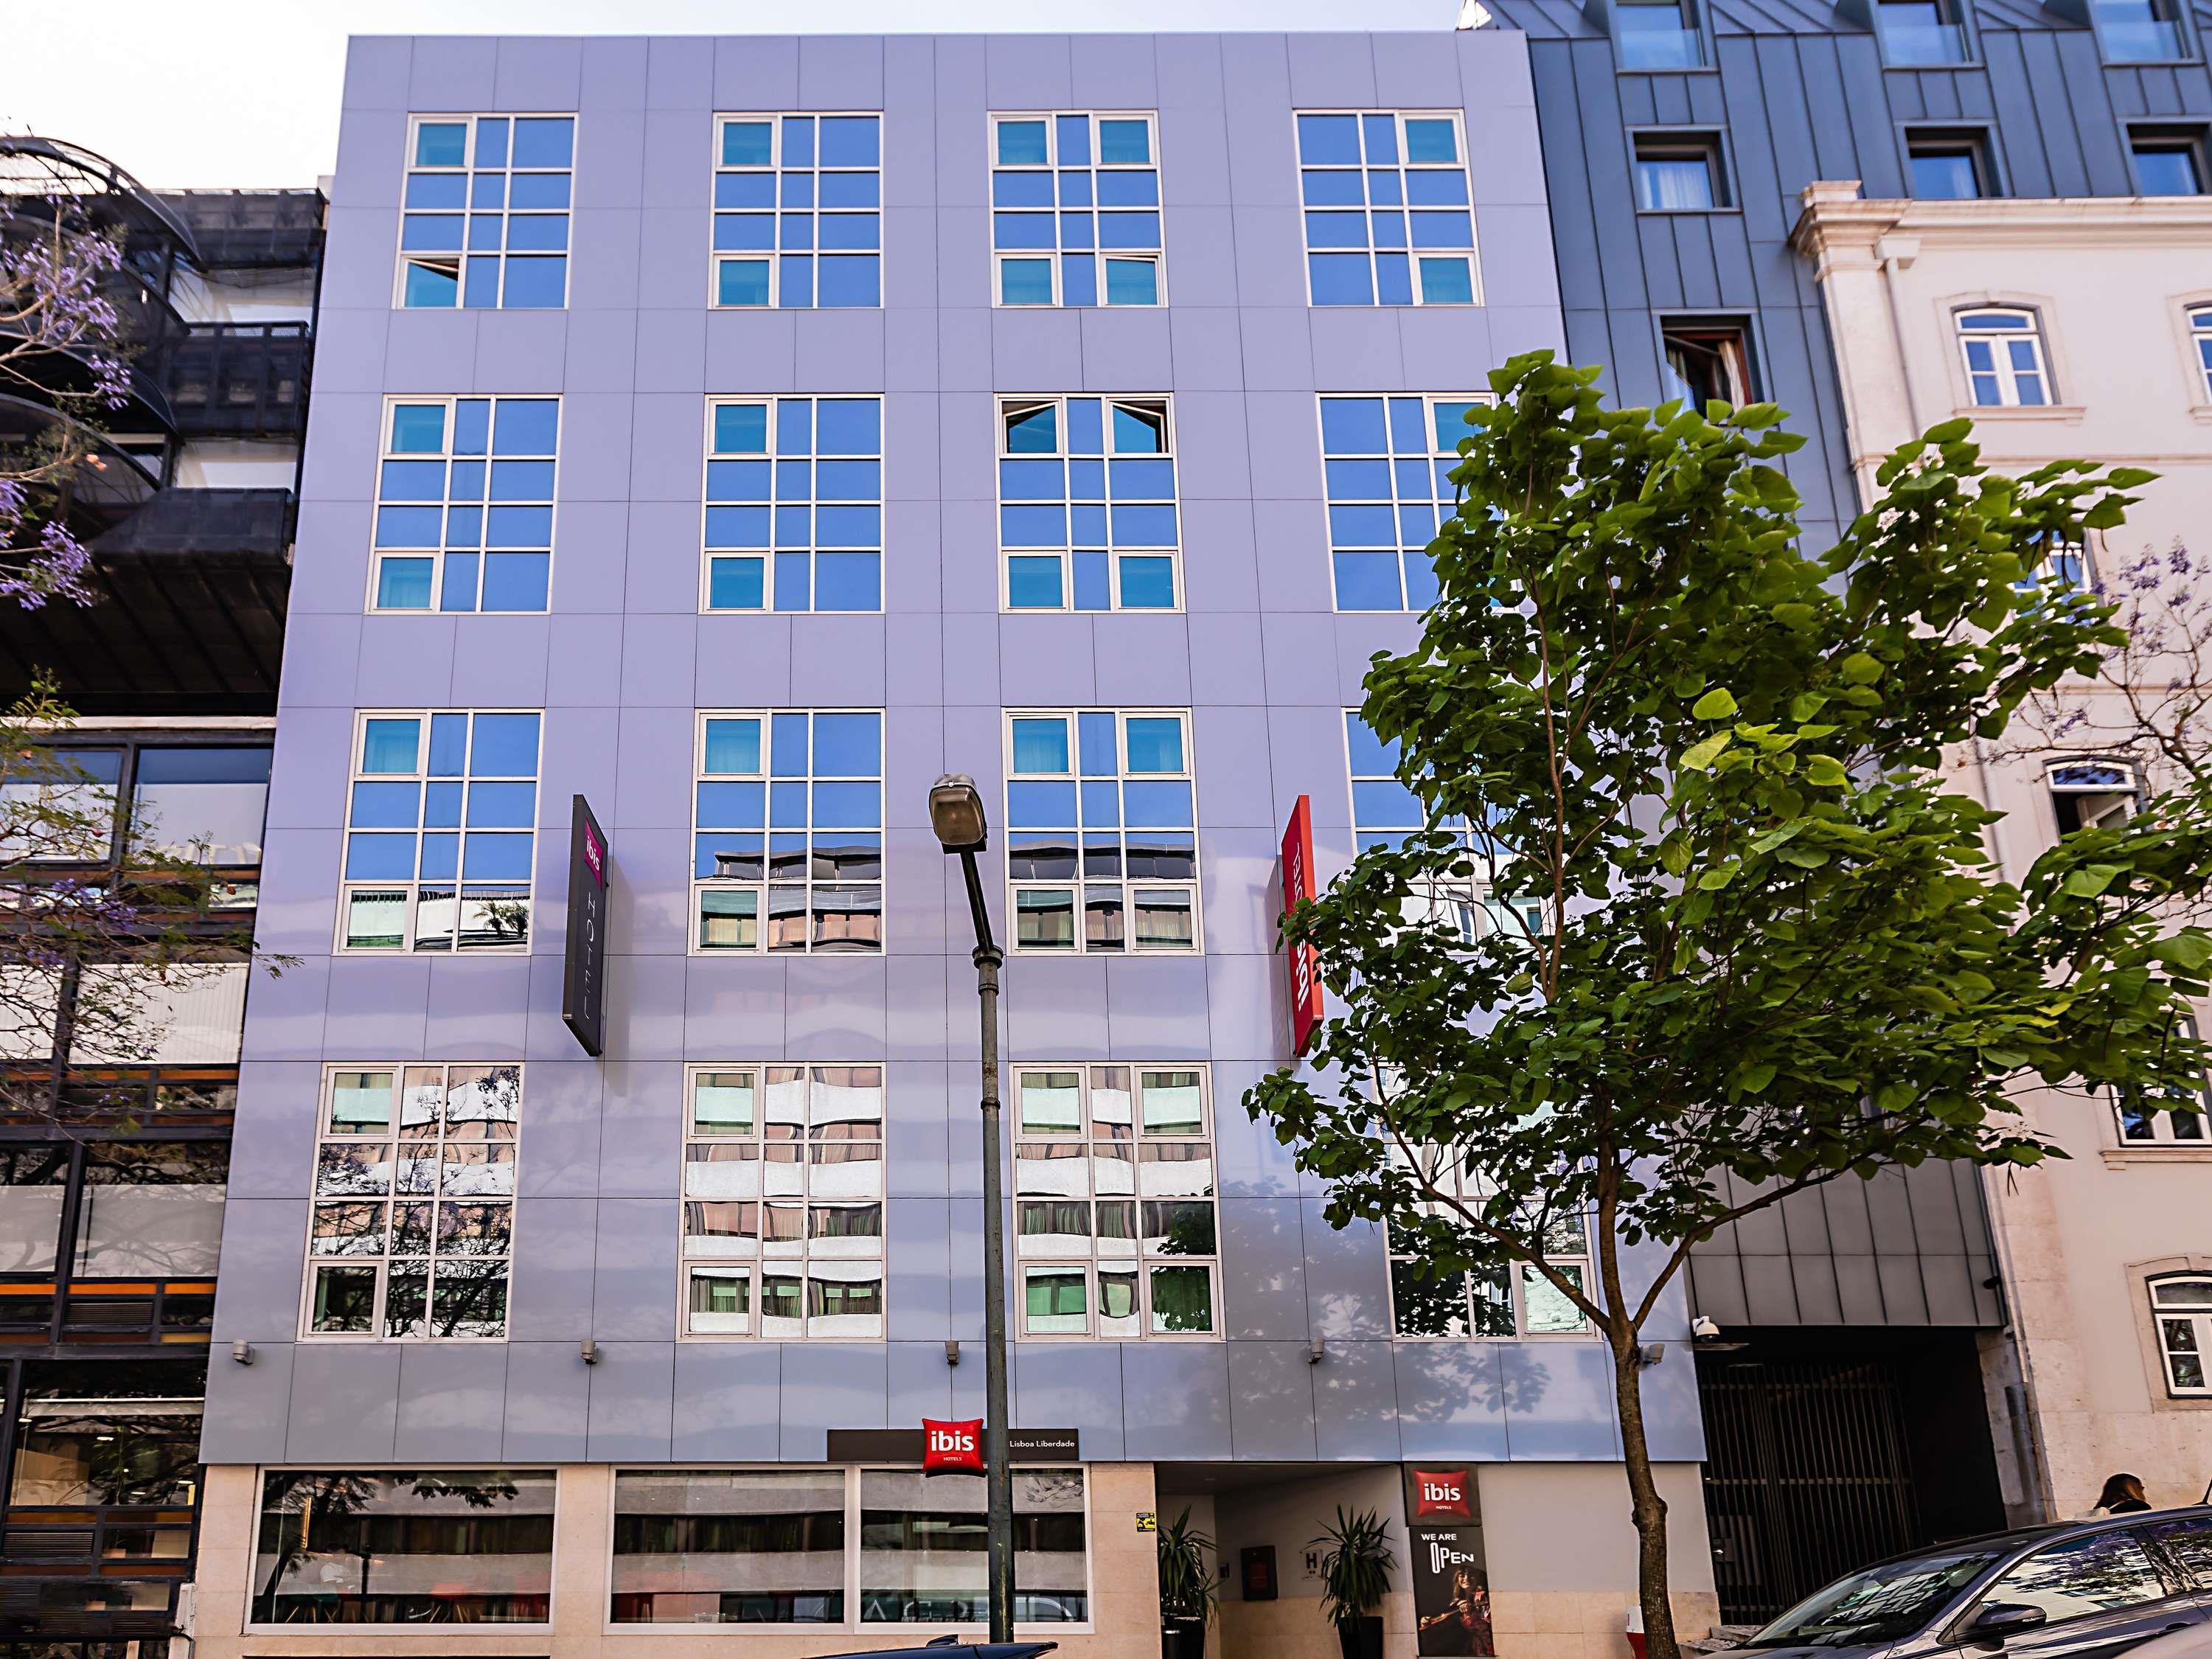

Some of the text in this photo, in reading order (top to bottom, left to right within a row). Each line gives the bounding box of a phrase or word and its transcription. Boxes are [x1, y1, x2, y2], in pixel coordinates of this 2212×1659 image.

[586, 835, 599, 872] ibis
[1293, 842, 1303, 914] OTEL
[1295, 938, 1310, 1012] ibis
[931, 1430, 975, 1452] ibis
[1424, 1483, 1461, 1501] ibis
[1306, 1552, 1318, 1569] H
[1430, 1542, 1475, 1574] OPEN
